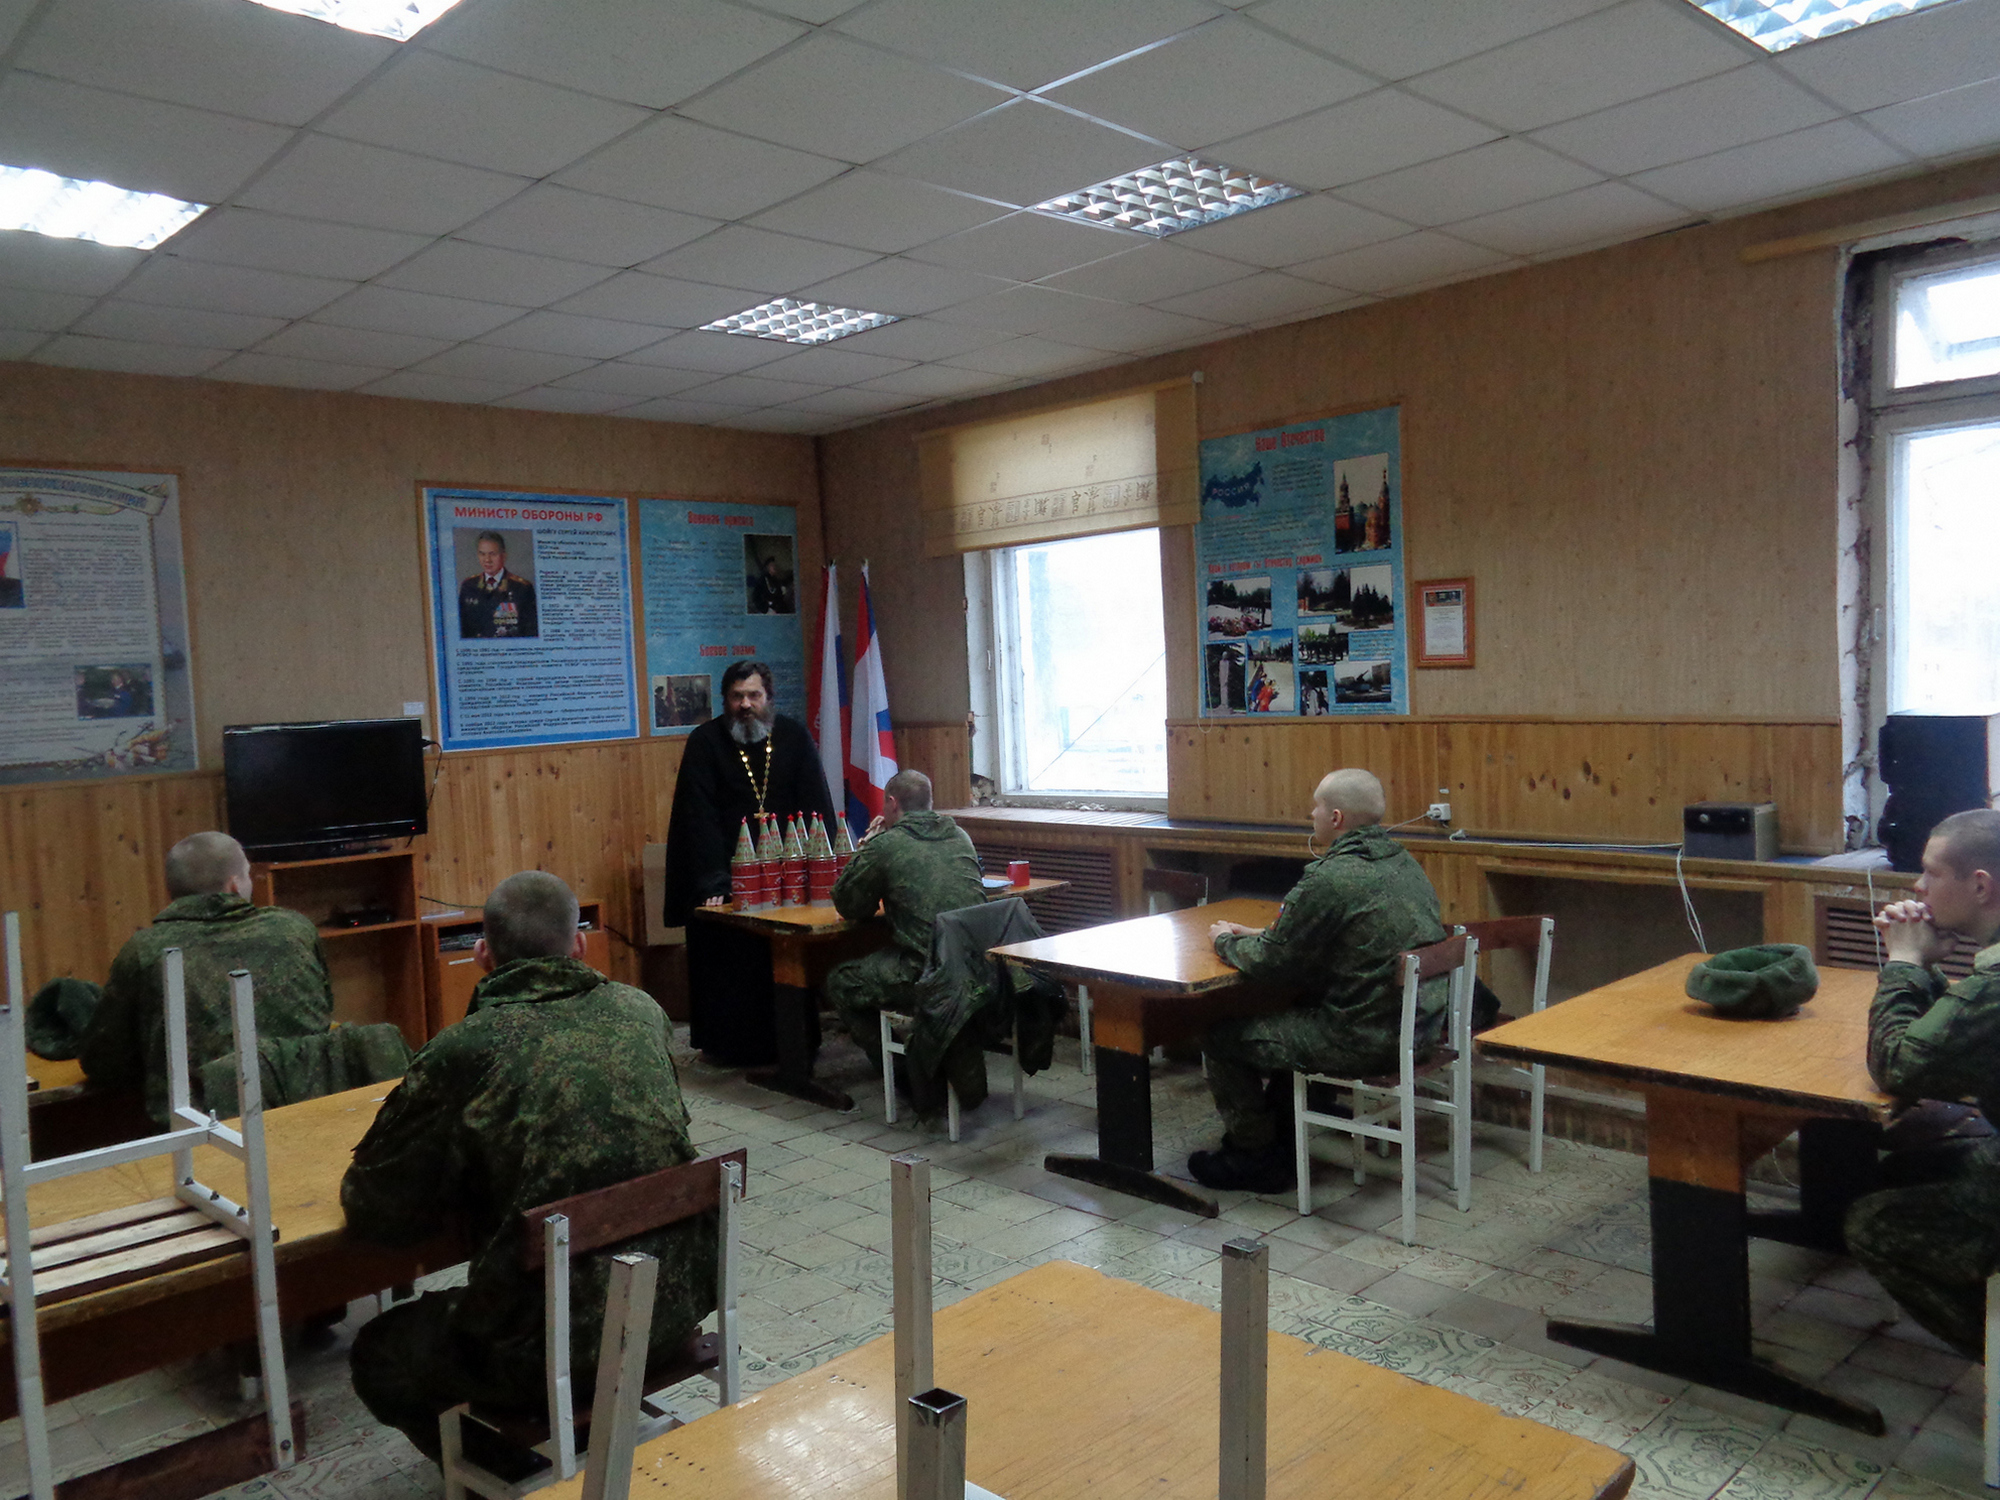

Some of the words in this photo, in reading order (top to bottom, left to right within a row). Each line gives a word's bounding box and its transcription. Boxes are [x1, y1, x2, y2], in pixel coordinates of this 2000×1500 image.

[1281, 429, 1325, 447] Отечество
[1212, 482, 1250, 497] РОССИЯ
[454, 506, 518, 519] МИНИСТР
[522, 509, 583, 521] ОБОРОНЫ
[587, 512, 603, 522] РФ
